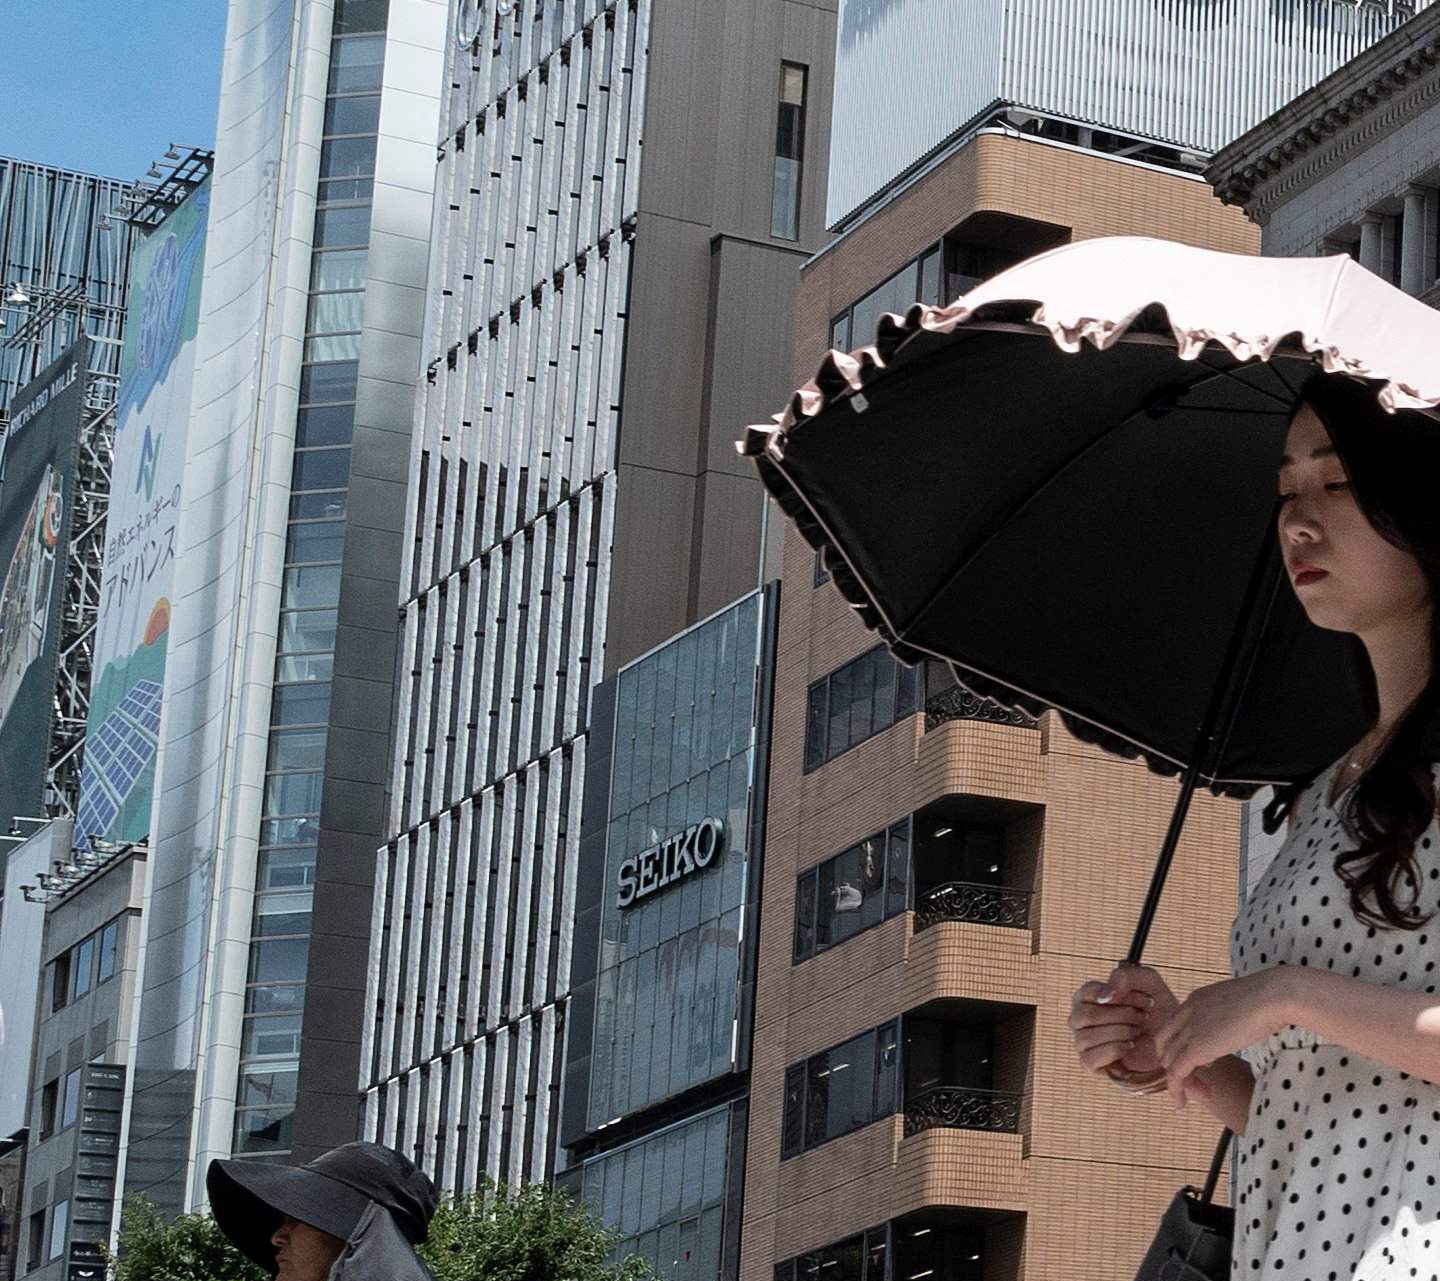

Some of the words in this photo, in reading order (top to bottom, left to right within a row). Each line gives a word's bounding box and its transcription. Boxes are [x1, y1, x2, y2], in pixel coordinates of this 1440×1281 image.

[103, 525, 176, 618] アドバンス
[616, 816, 722, 909] SEIKO
